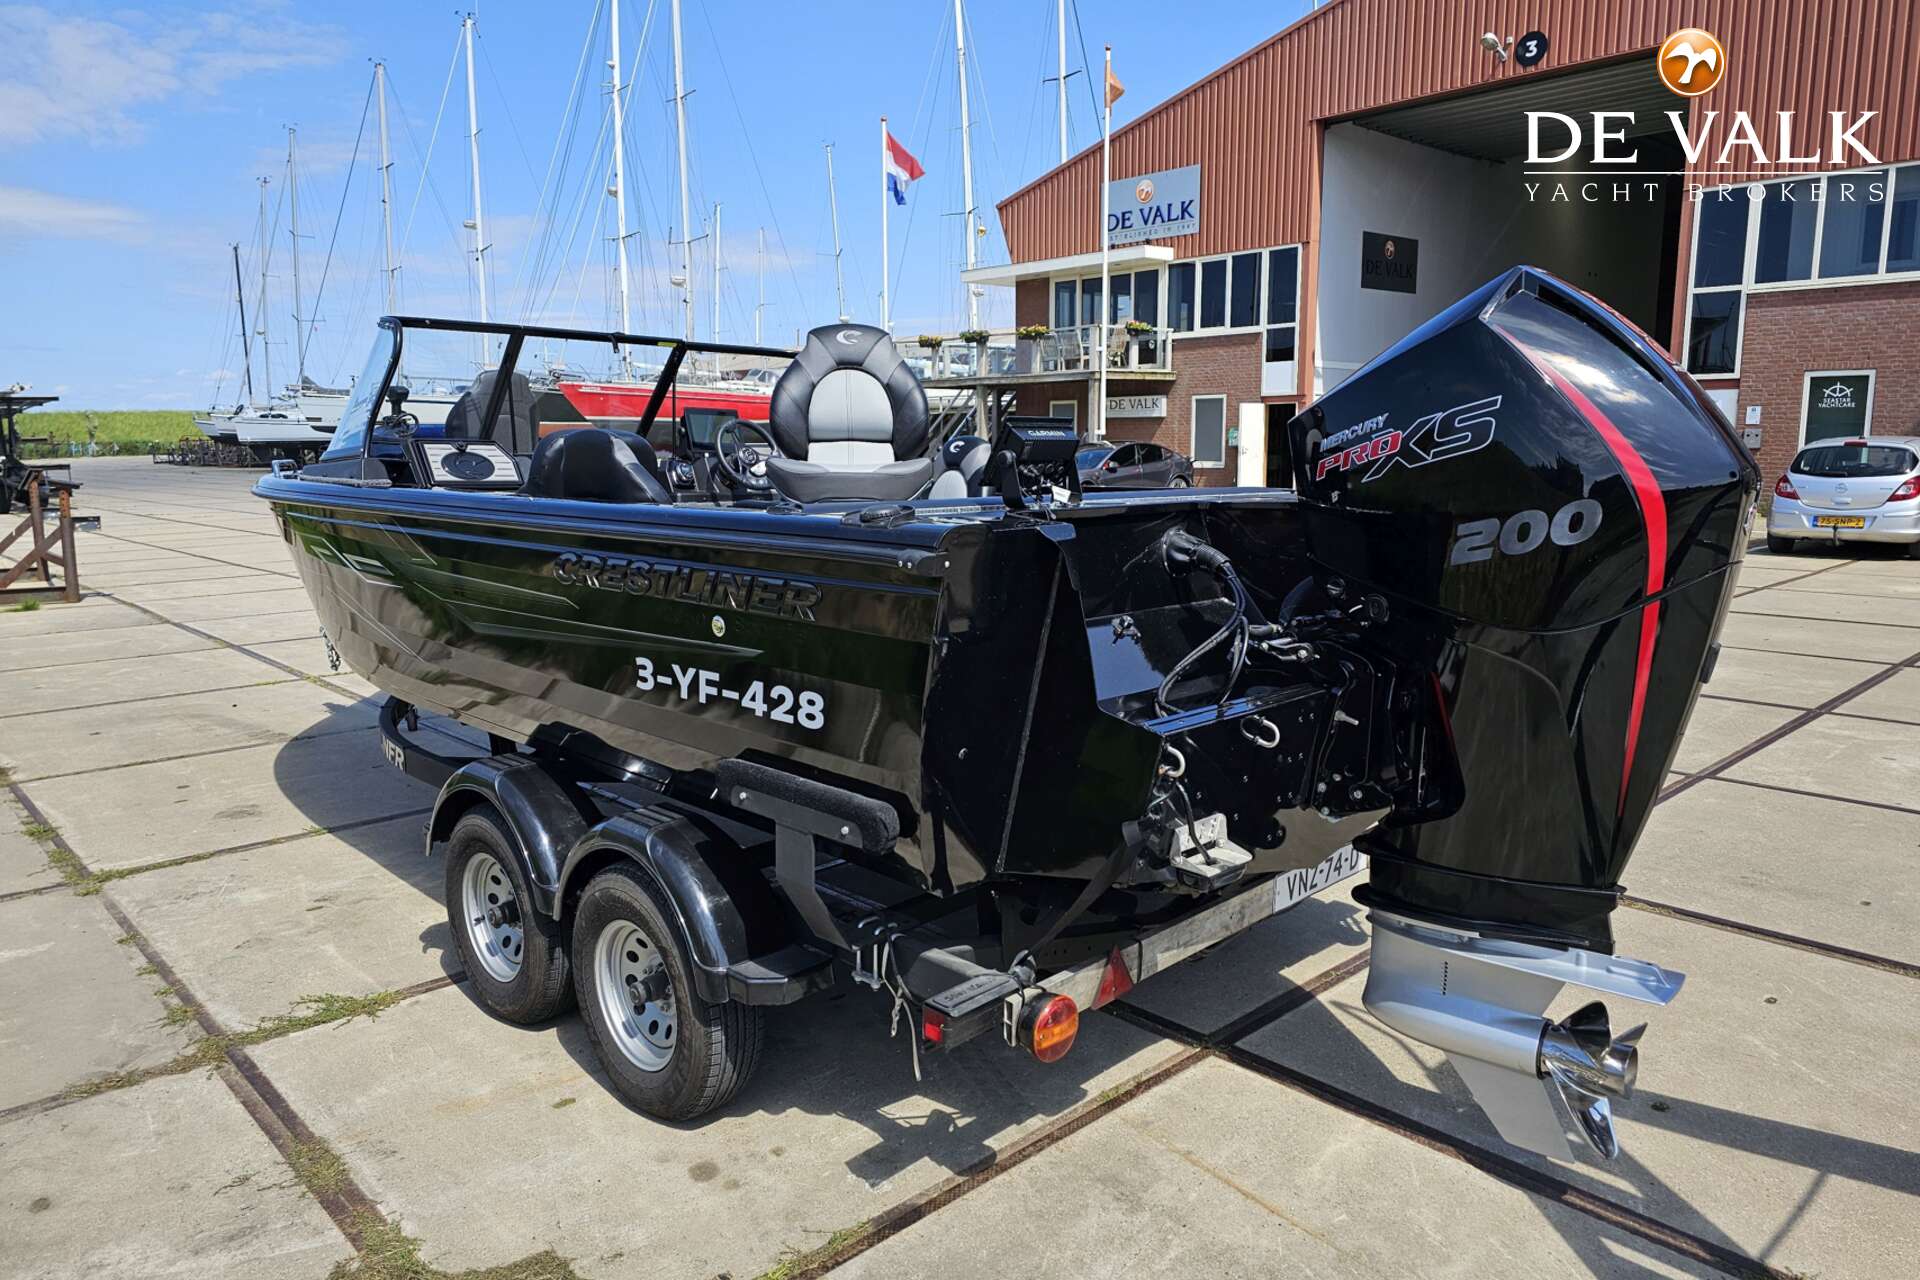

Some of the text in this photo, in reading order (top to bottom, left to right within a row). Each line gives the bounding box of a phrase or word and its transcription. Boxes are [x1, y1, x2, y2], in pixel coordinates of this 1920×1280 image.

[1525, 39, 1538, 57] 3
[1108, 200, 1195, 232] DE VALK
[1109, 397, 1160, 410] DE VALK
[1320, 412, 1389, 452] MERCURY
[1316, 430, 1402, 482] PRO
[1450, 499, 1603, 566] 200
[551, 551, 823, 622] CRESTLINER
[635, 656, 825, 730] 3-YF-428
